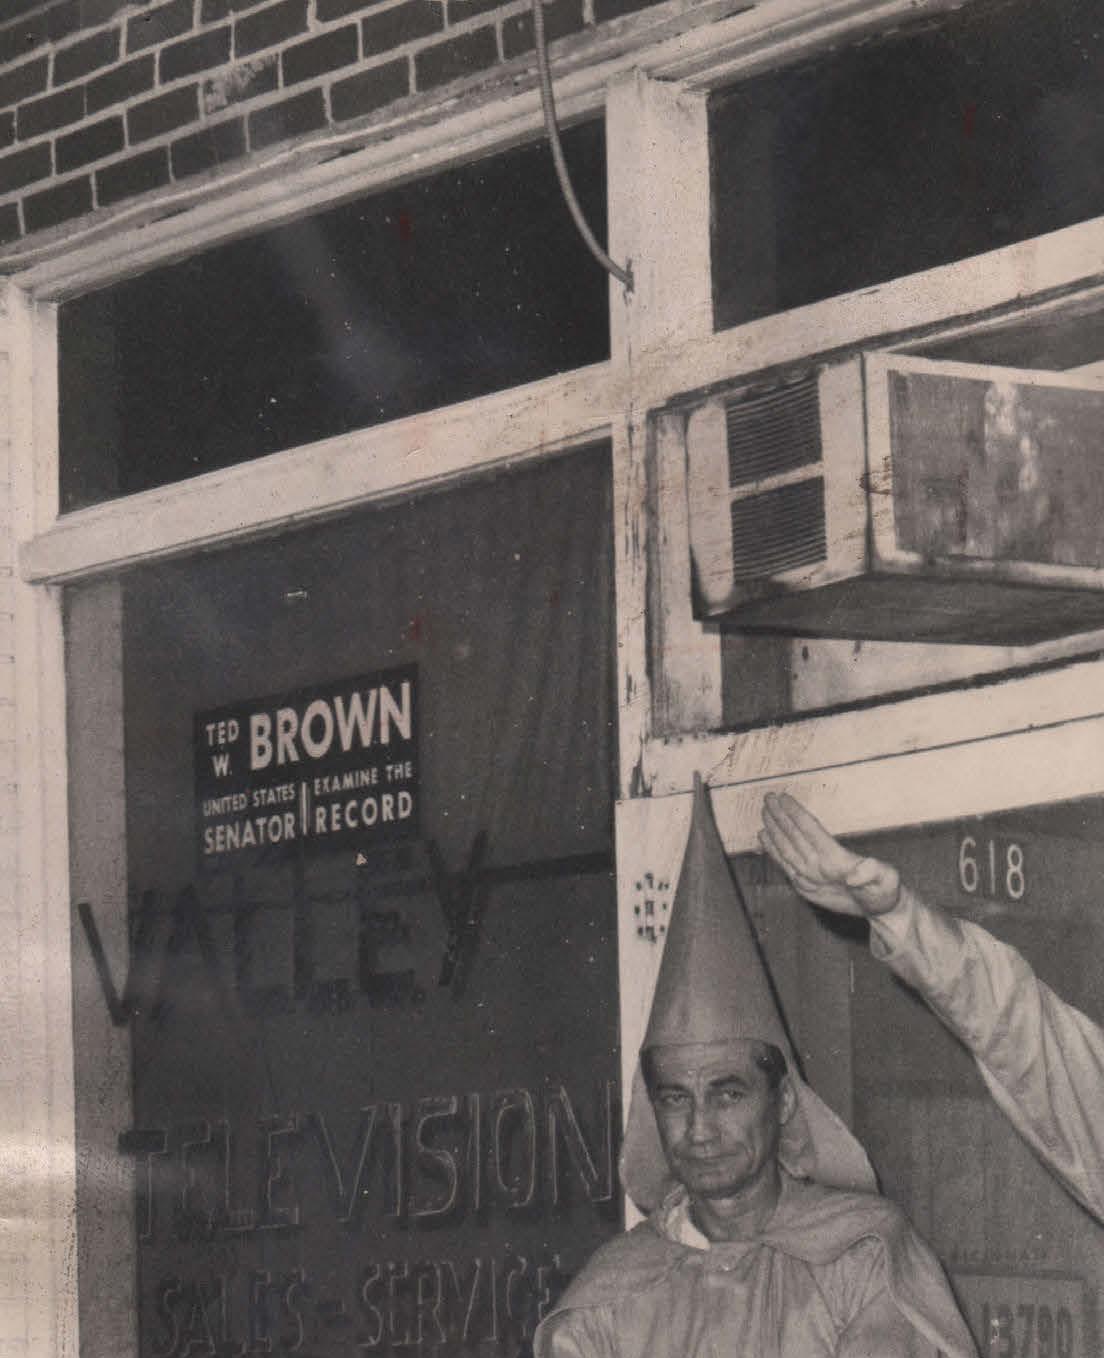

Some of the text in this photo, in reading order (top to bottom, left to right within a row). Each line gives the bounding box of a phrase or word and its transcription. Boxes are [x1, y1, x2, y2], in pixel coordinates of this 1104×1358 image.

[206, 718, 241, 747] TED
[250, 680, 412, 772] BROWN
[211, 753, 233, 778] W.
[314, 760, 414, 797] EXAMINE THE
[203, 782, 297, 818] UNITED STATES
[315, 790, 414, 836] RECORD
[203, 811, 297, 855] SENATOR
[959, 836, 1025, 899] 618
[117, 1076, 617, 1242] TELEVISION
[152, 1266, 310, 1358] SALES
